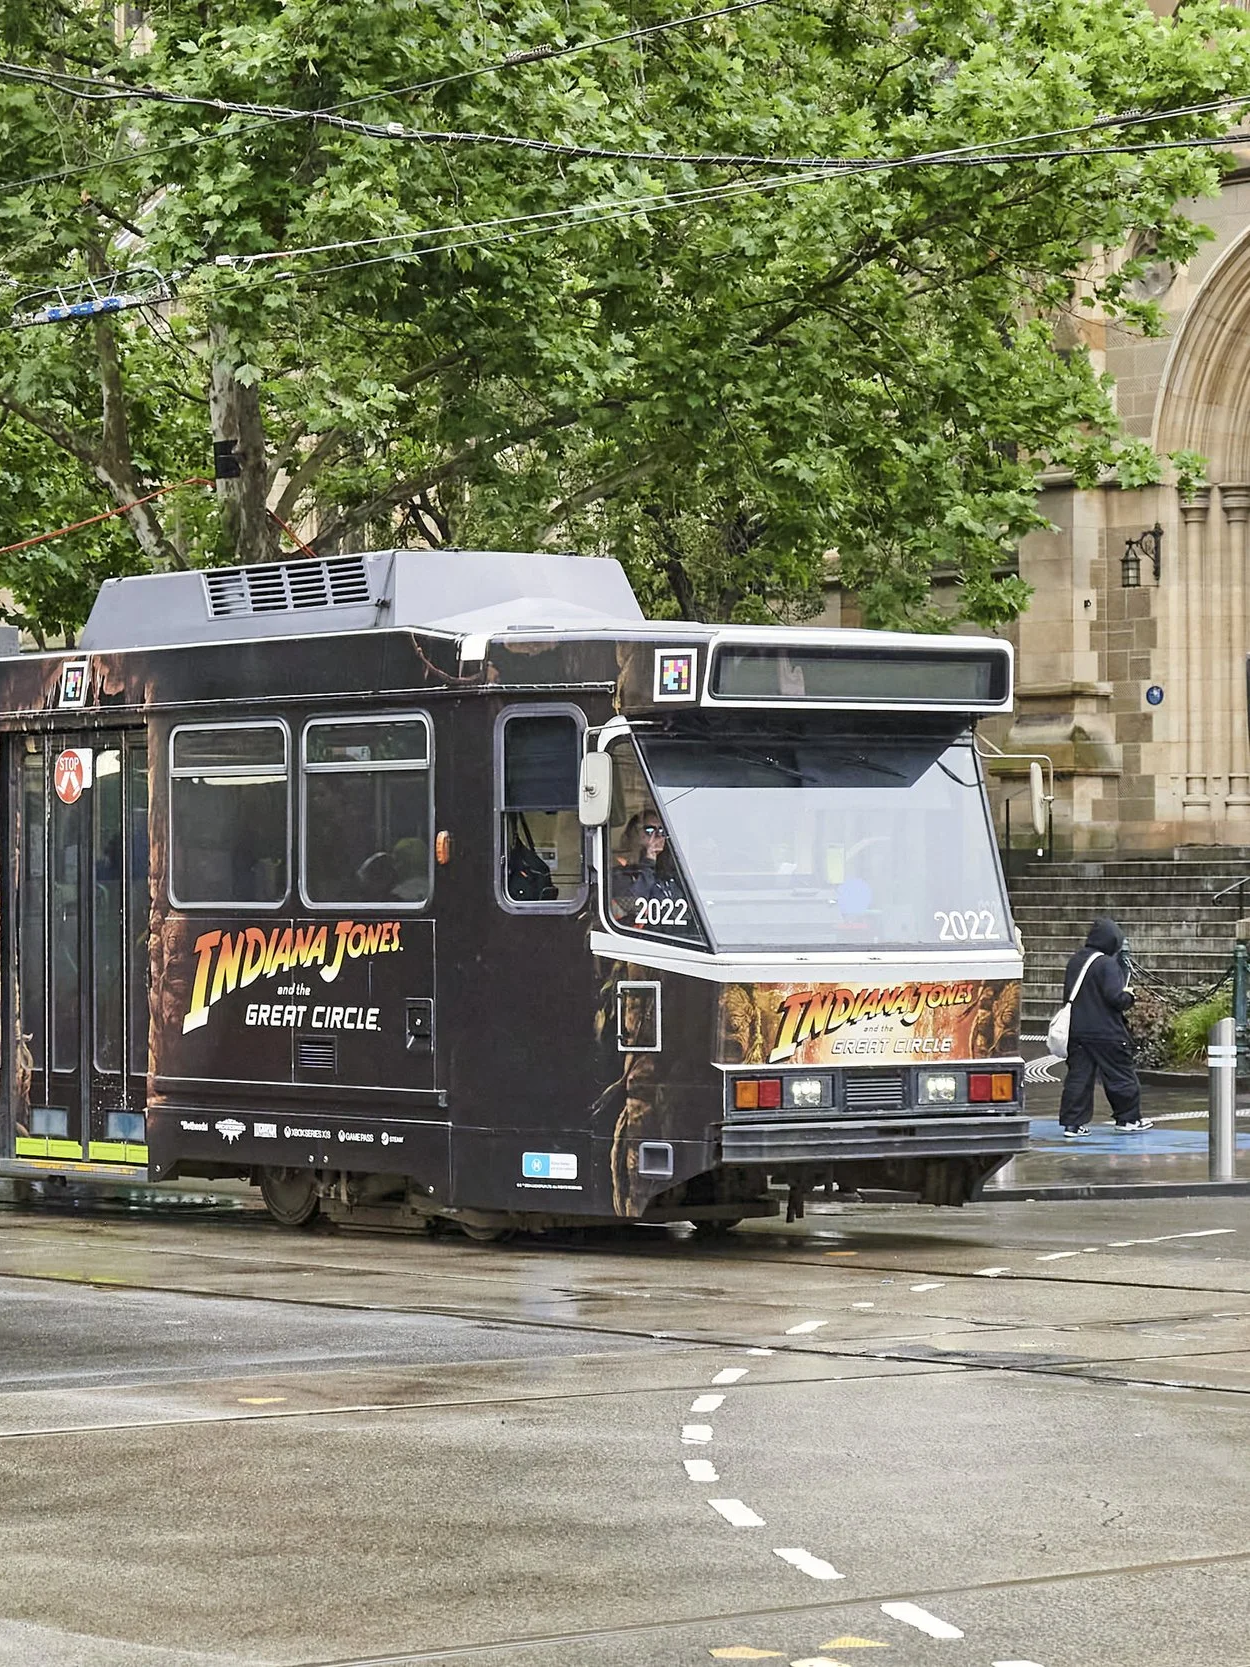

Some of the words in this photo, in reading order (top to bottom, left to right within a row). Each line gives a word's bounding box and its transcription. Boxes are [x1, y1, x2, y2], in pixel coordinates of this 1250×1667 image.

[59, 757, 80, 771] STOP
[634, 897, 688, 925] 2022
[934, 910, 1000, 941] 2022
[182, 925, 328, 1035] INDIANA
[277, 983, 295, 996] and
[295, 983, 311, 996] the
[245, 1003, 307, 1028] GREAT
[767, 987, 911, 1064] INDIANA
[900, 983, 973, 1026] JONES
[880, 1025, 893, 1033] the
[831, 1038, 890, 1054] GREAT
[894, 1037, 952, 1053] CIRCLE
[345, 1132, 361, 1141] GAME
[361, 1133, 374, 1142] PASS
